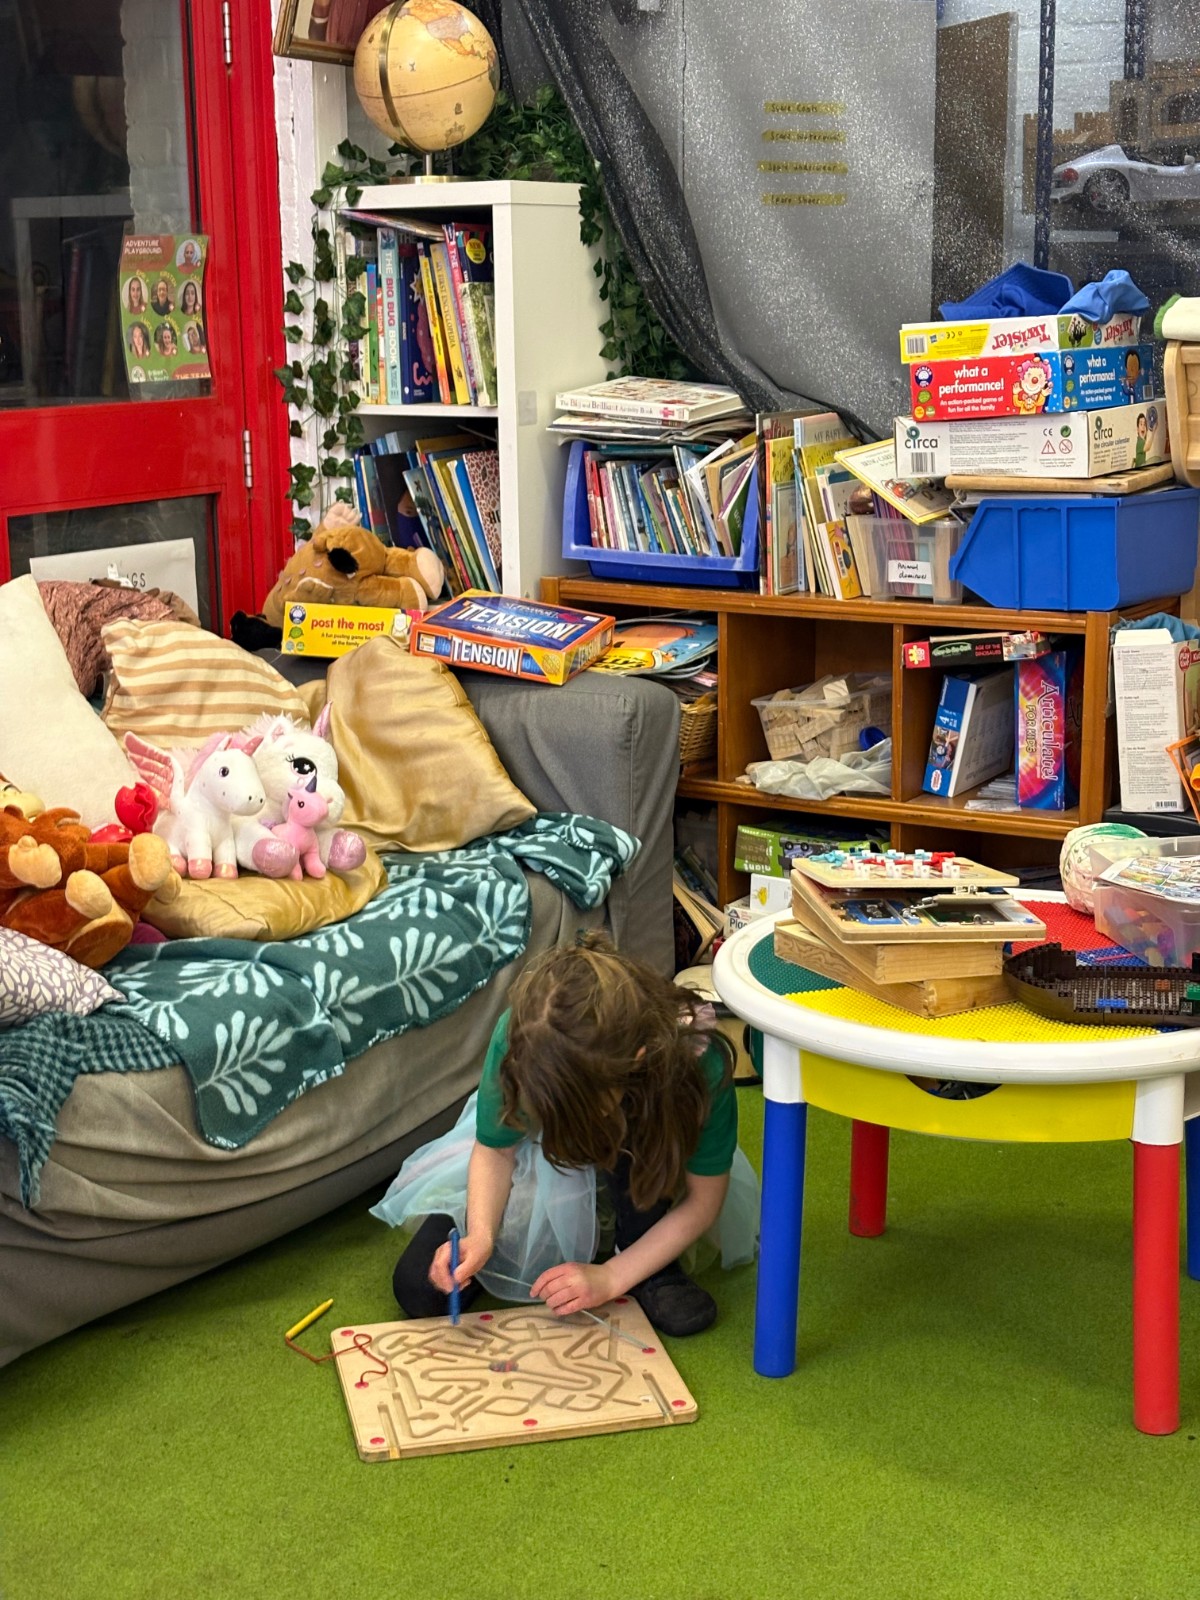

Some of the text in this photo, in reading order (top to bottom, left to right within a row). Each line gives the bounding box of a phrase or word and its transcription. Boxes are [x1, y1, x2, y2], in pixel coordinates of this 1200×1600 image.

[124, 246, 162, 255] PLAYGROUND
[125, 239, 160, 247] ADVENTURE
[385, 251, 393, 275] THE
[386, 277, 394, 298] BIG
[438, 273, 448, 293] FIRST
[387, 301, 396, 327] BUG
[441, 294, 456, 348] ENCYCLOPEDIA
[991, 323, 1052, 351] Twister
[1104, 319, 1135, 342] Twister
[389, 329, 398, 365] BOOK
[954, 364, 988, 378] what a
[1087, 354, 1101, 368] what
[1102, 358, 1107, 366] a
[1079, 368, 1116, 387] performance!
[938, 378, 1005, 398] performance!
[570, 399, 582, 410] Big
[591, 400, 619, 412] Brilliant
[980, 404, 995, 413] family
[905, 432, 938, 449] circa
[1093, 422, 1113, 441] circa
[311, 617, 385, 632] post the most
[456, 601, 581, 640] TENSION
[450, 635, 521, 674] TENSION
[1025, 704, 1037, 753] FOR KIDS
[1037, 679, 1063, 782] Articulate!
